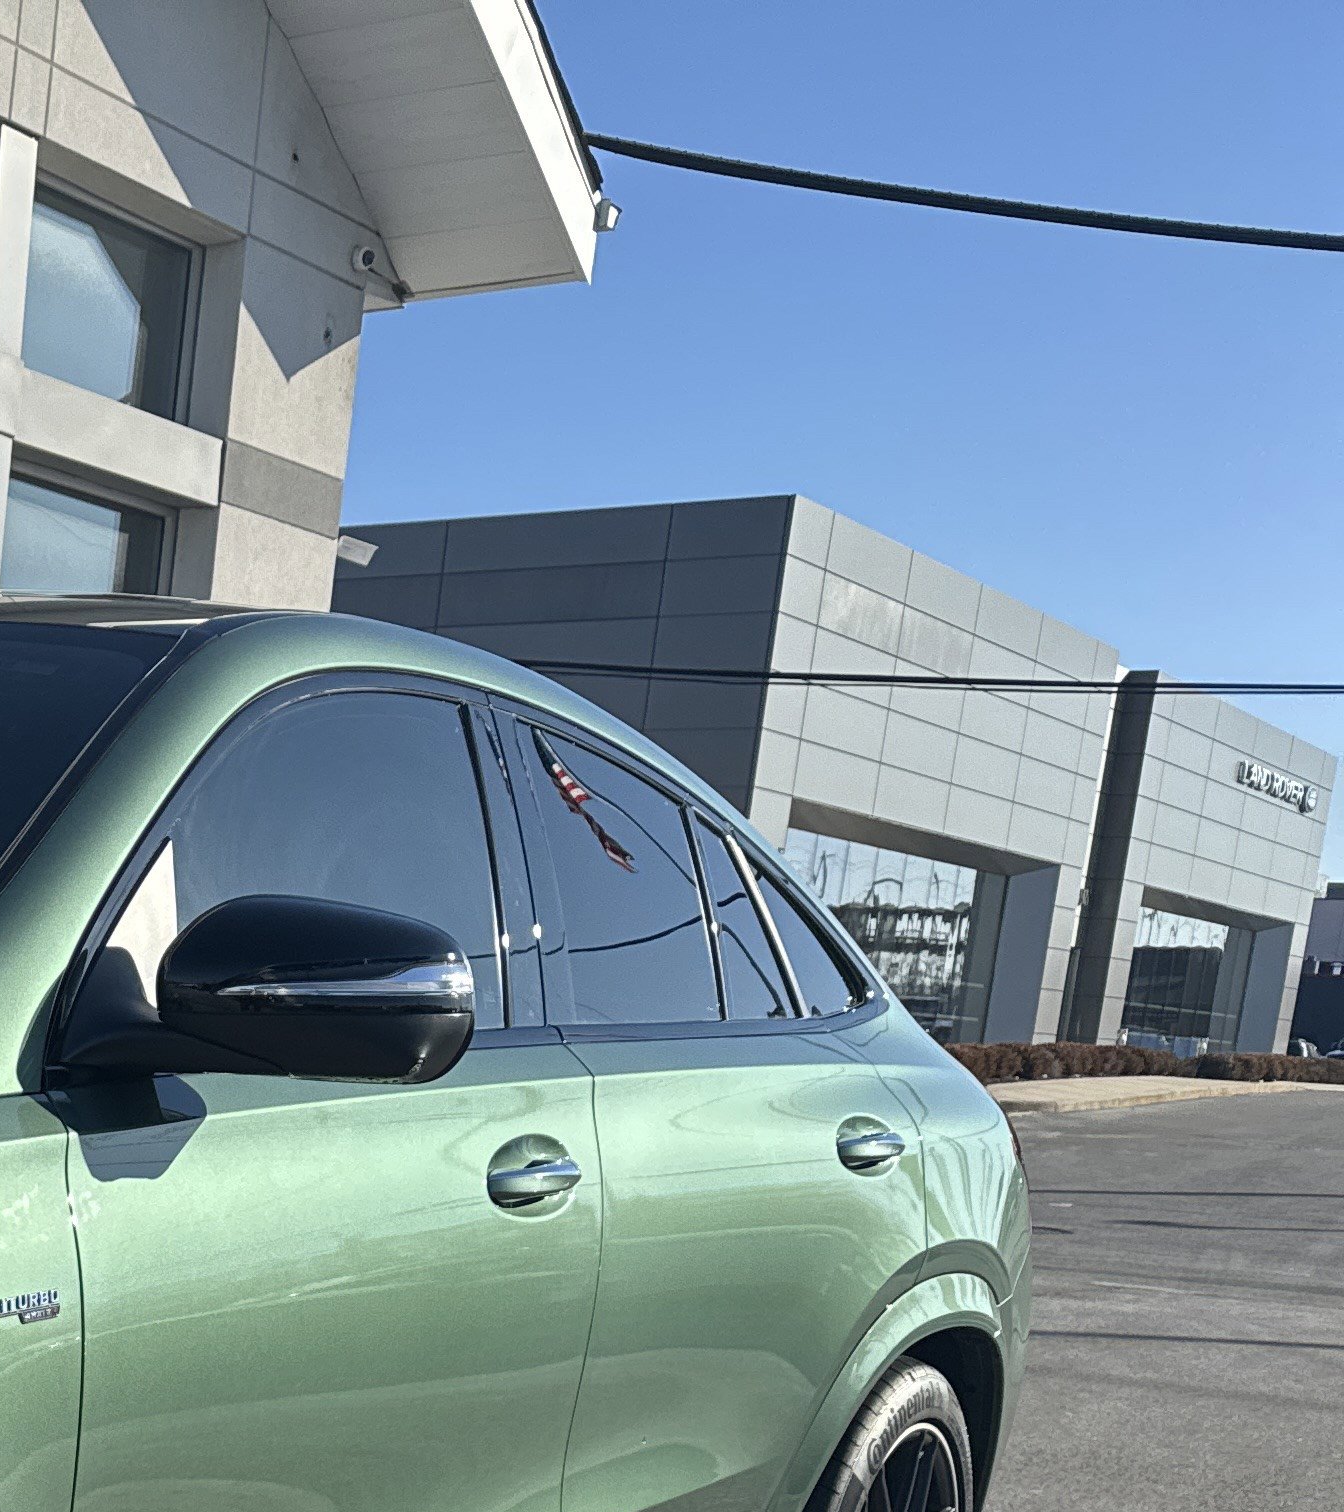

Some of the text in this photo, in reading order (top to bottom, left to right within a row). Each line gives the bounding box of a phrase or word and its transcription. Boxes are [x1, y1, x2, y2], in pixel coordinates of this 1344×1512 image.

[1242, 760, 1272, 793] LAND
[1272, 772, 1305, 806] ROVER
[867, 1380, 936, 1476] Continental
